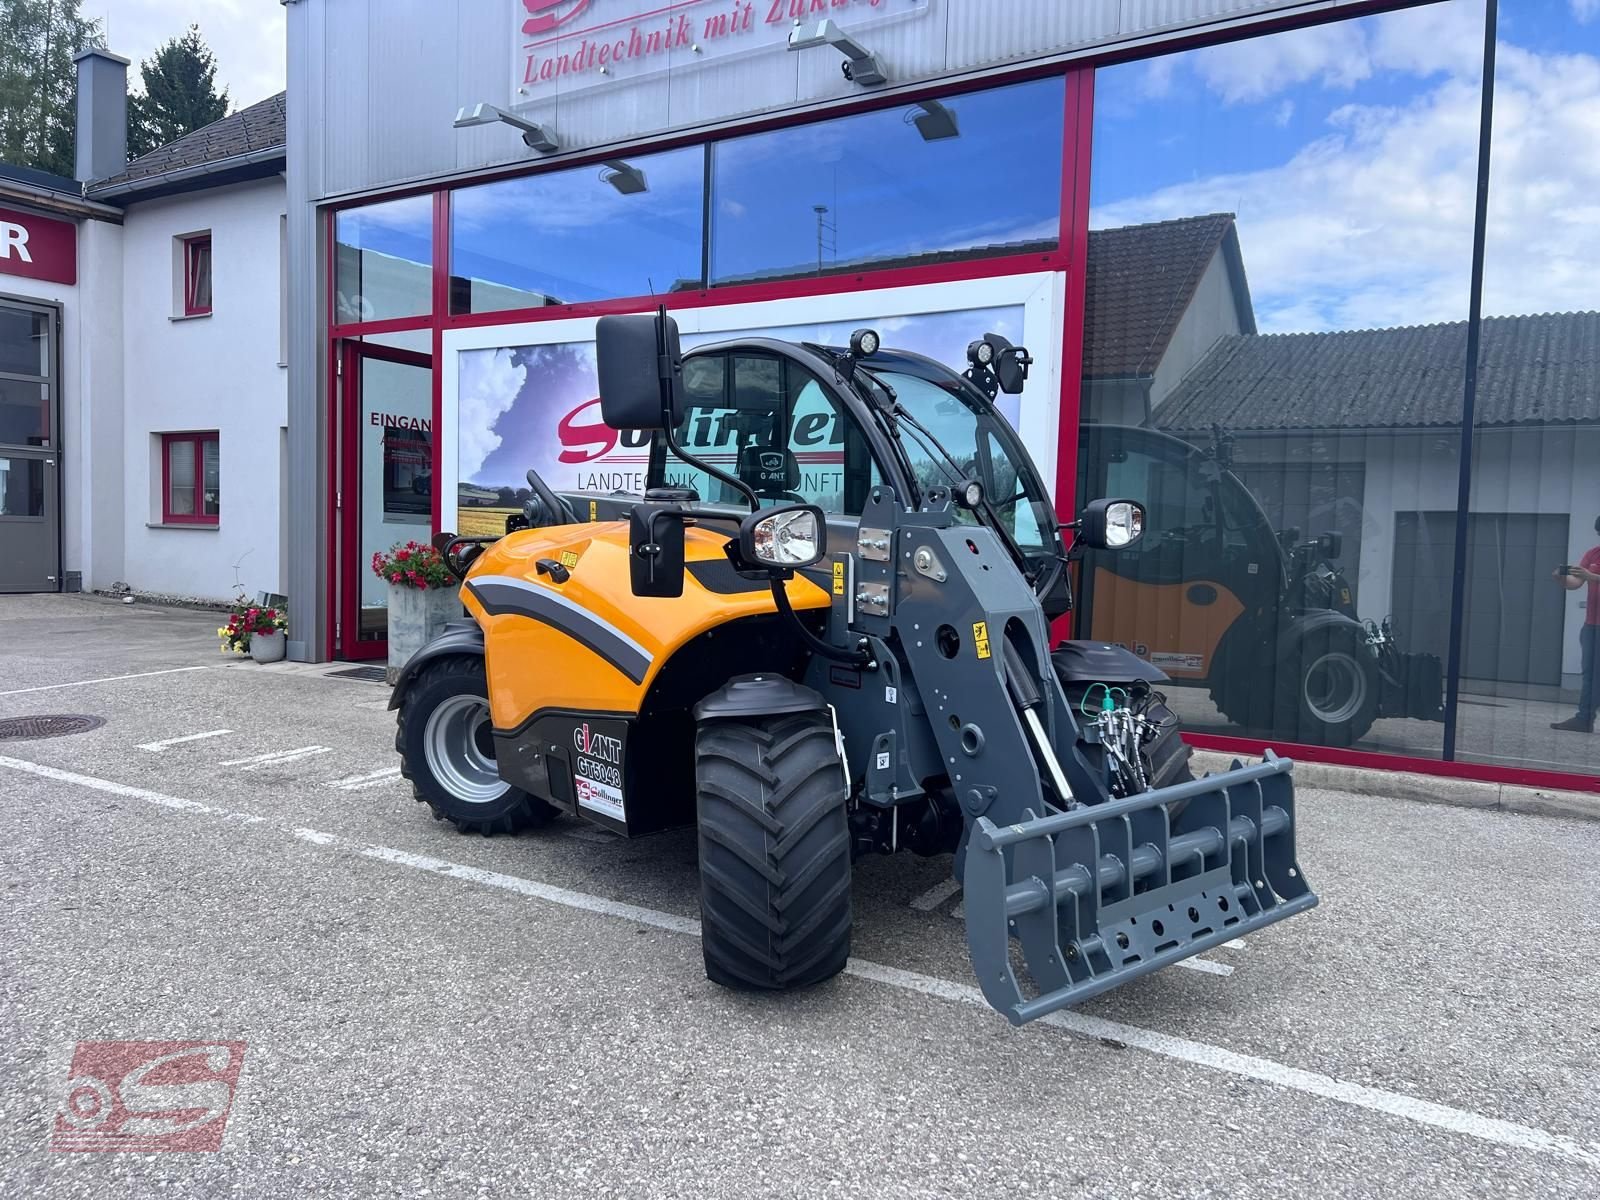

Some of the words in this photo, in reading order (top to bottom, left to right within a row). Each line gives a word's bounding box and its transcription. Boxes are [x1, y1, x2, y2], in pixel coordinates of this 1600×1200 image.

[523, 14, 690, 84] Landtechnik
[703, 0, 752, 39] mit
[371, 412, 432, 432] EINGAN
[760, 472, 785, 480] GANT
[577, 756, 621, 788] GT5048
